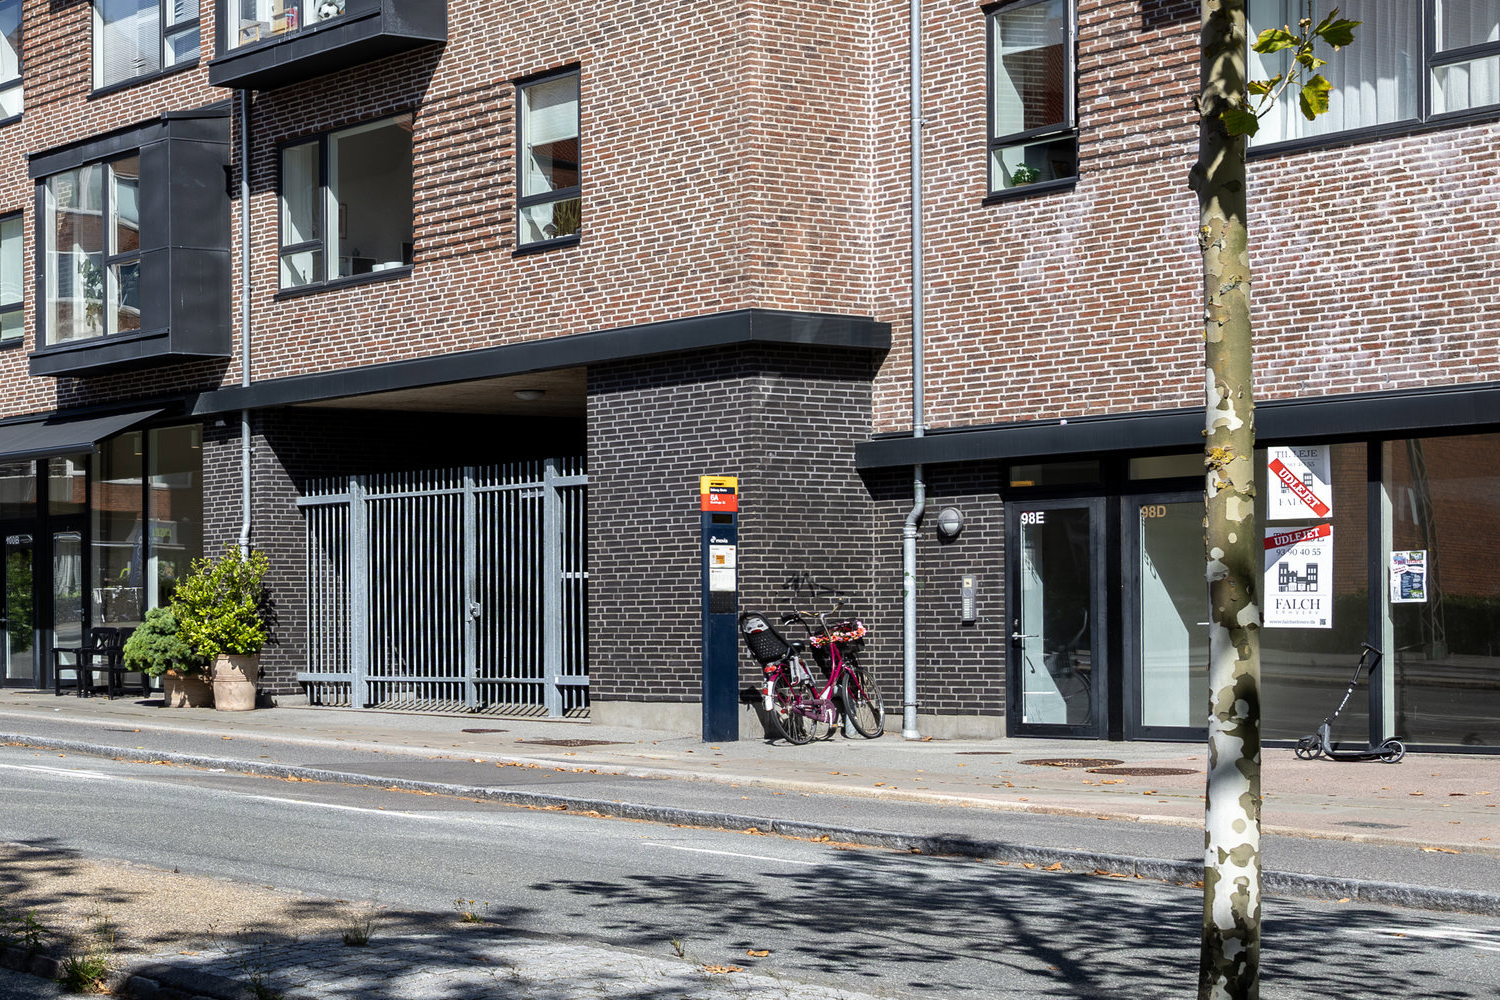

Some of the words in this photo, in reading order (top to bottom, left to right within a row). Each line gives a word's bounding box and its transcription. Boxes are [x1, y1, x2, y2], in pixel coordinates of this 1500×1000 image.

[1294, 449, 1318, 458] LEJE
[1279, 467, 1320, 508] UDLEJET
[1021, 512, 1044, 524] 98E
[1141, 506, 1166, 518] 98D
[1274, 527, 1320, 546] UDLEJET
[1276, 548, 1286, 556] 93
[1288, 548, 1298, 556] 90
[1299, 548, 1310, 556] 40
[1311, 548, 1321, 556] 55
[1275, 598, 1321, 610] FALCH
